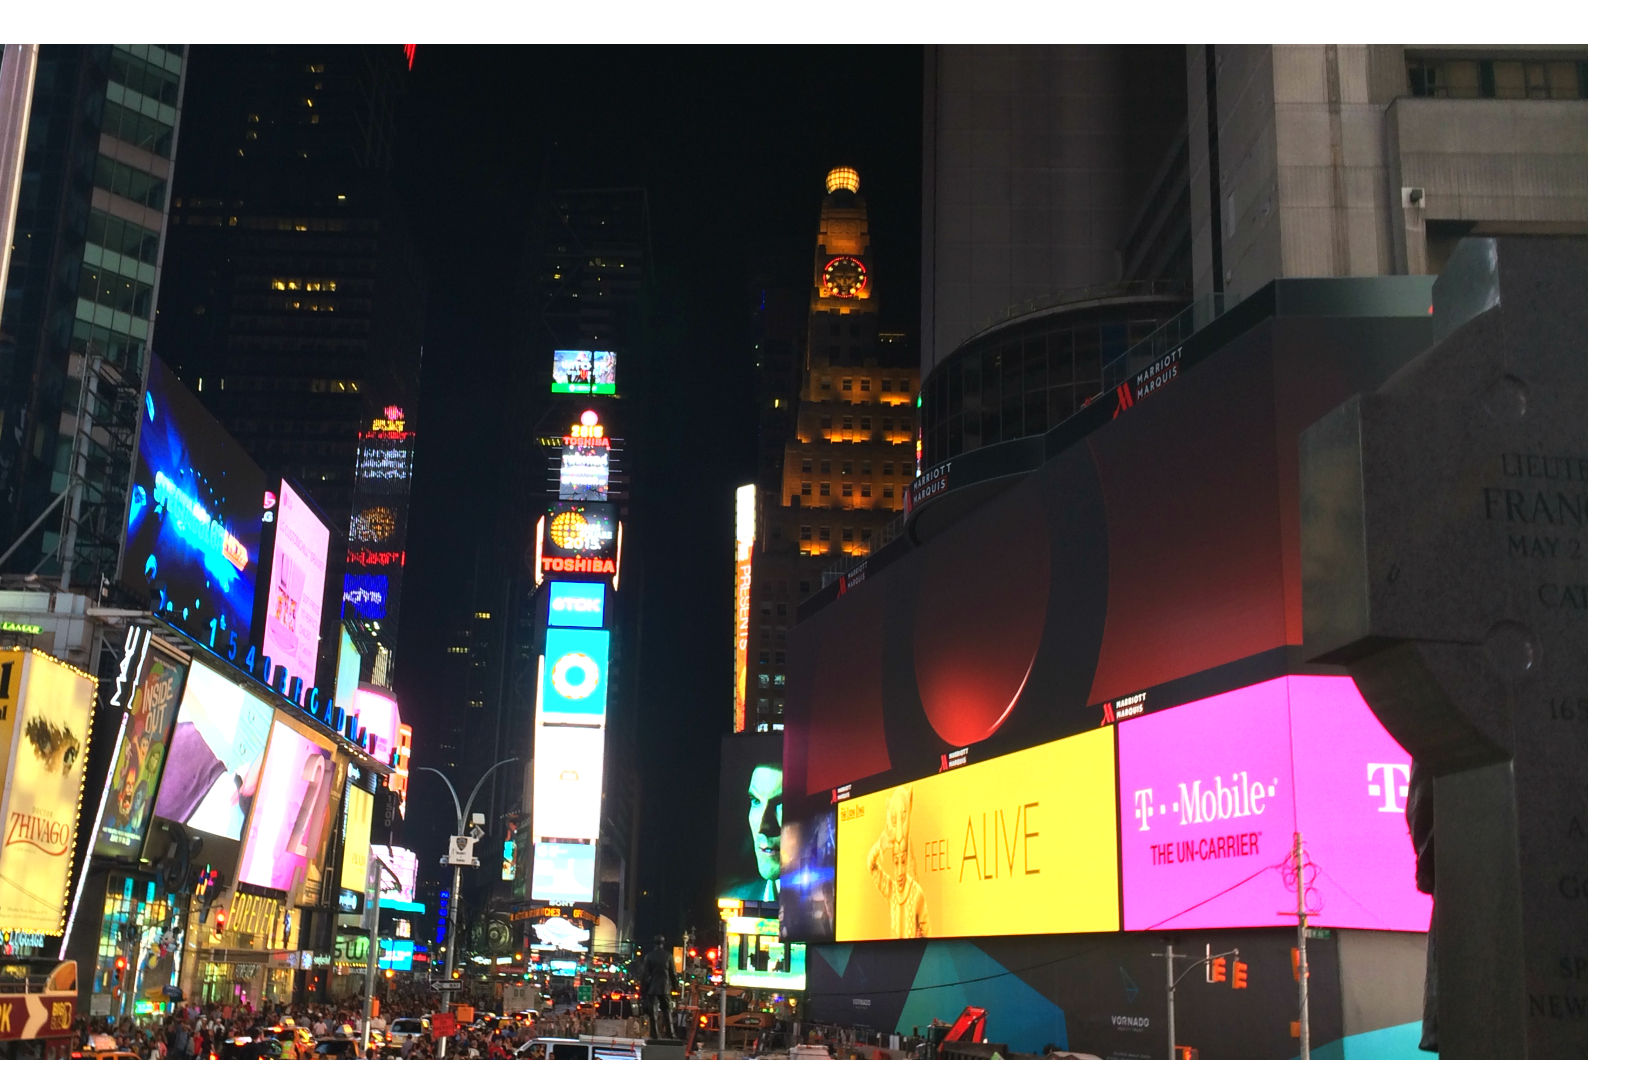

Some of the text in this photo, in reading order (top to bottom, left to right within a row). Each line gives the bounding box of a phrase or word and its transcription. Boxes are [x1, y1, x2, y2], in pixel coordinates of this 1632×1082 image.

[1137, 346, 1184, 384] MARRIOTT
[1137, 365, 1179, 400] MARQUIS
[563, 437, 610, 447] TOSHIBA
[913, 462, 952, 491] MARRIOTT
[913, 479, 948, 502] MARQUIS
[1483, 487, 1587, 525] FRAN
[1508, 535, 1559, 558] MAY
[542, 557, 616, 573] TOSHIBA
[1, 621, 42, 634] LAMAR
[142, 676, 174, 714] INSIDE
[145, 703, 168, 735] OUT
[5, 812, 71, 848] ZHIVAGO
[924, 801, 1041, 884] FEEL ALIVE
[1151, 842, 1175, 866] THE
[9, 930, 45, 948] LUGGAGE
[1111, 1015, 1150, 1028] VORNADO
